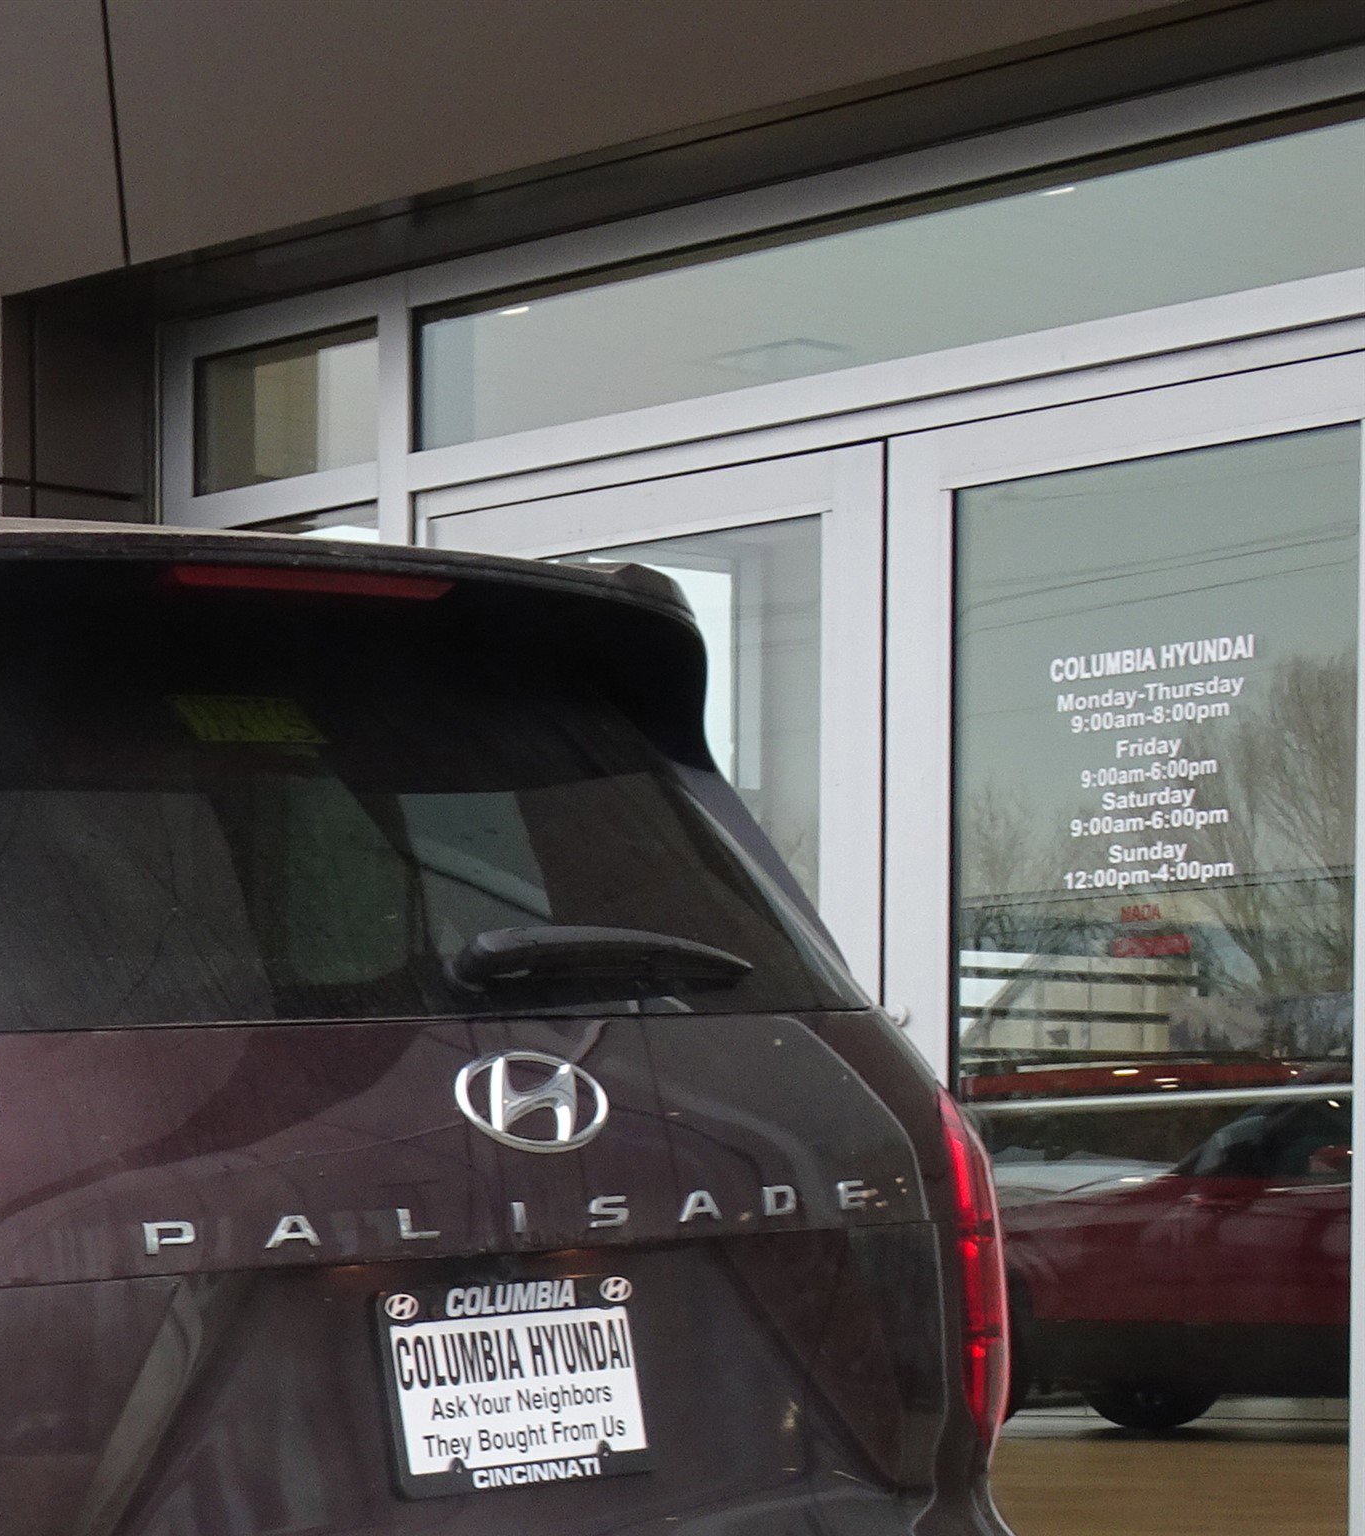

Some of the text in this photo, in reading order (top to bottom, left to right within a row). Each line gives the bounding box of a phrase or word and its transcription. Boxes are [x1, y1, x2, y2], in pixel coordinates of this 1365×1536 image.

[1050, 634, 1254, 682] COLUMBIA HYUNDAI
[1057, 676, 1244, 712] Monday-Thursday
[1070, 702, 1230, 734] 9:00am-8:00pm
[1116, 736, 1182, 759] Friday
[1080, 758, 1217, 788] 9:00am-6:00pm
[1102, 787, 1196, 811] Saturday
[1070, 808, 1229, 837] 9:00am-6:00pm
[1108, 841, 1187, 863] Sunday
[1063, 861, 1234, 890] 12:00pm-4:00pm
[142, 1179, 873, 1256] PALISADE
[445, 1279, 576, 1318] COLUMBIA
[396, 1318, 631, 1391] COLUMBIA HYUNDAI
[431, 1383, 612, 1421] Ask Your Neighbors
[422, 1415, 626, 1459] They Bought From Us
[473, 1457, 601, 1489] CINCINNATI
